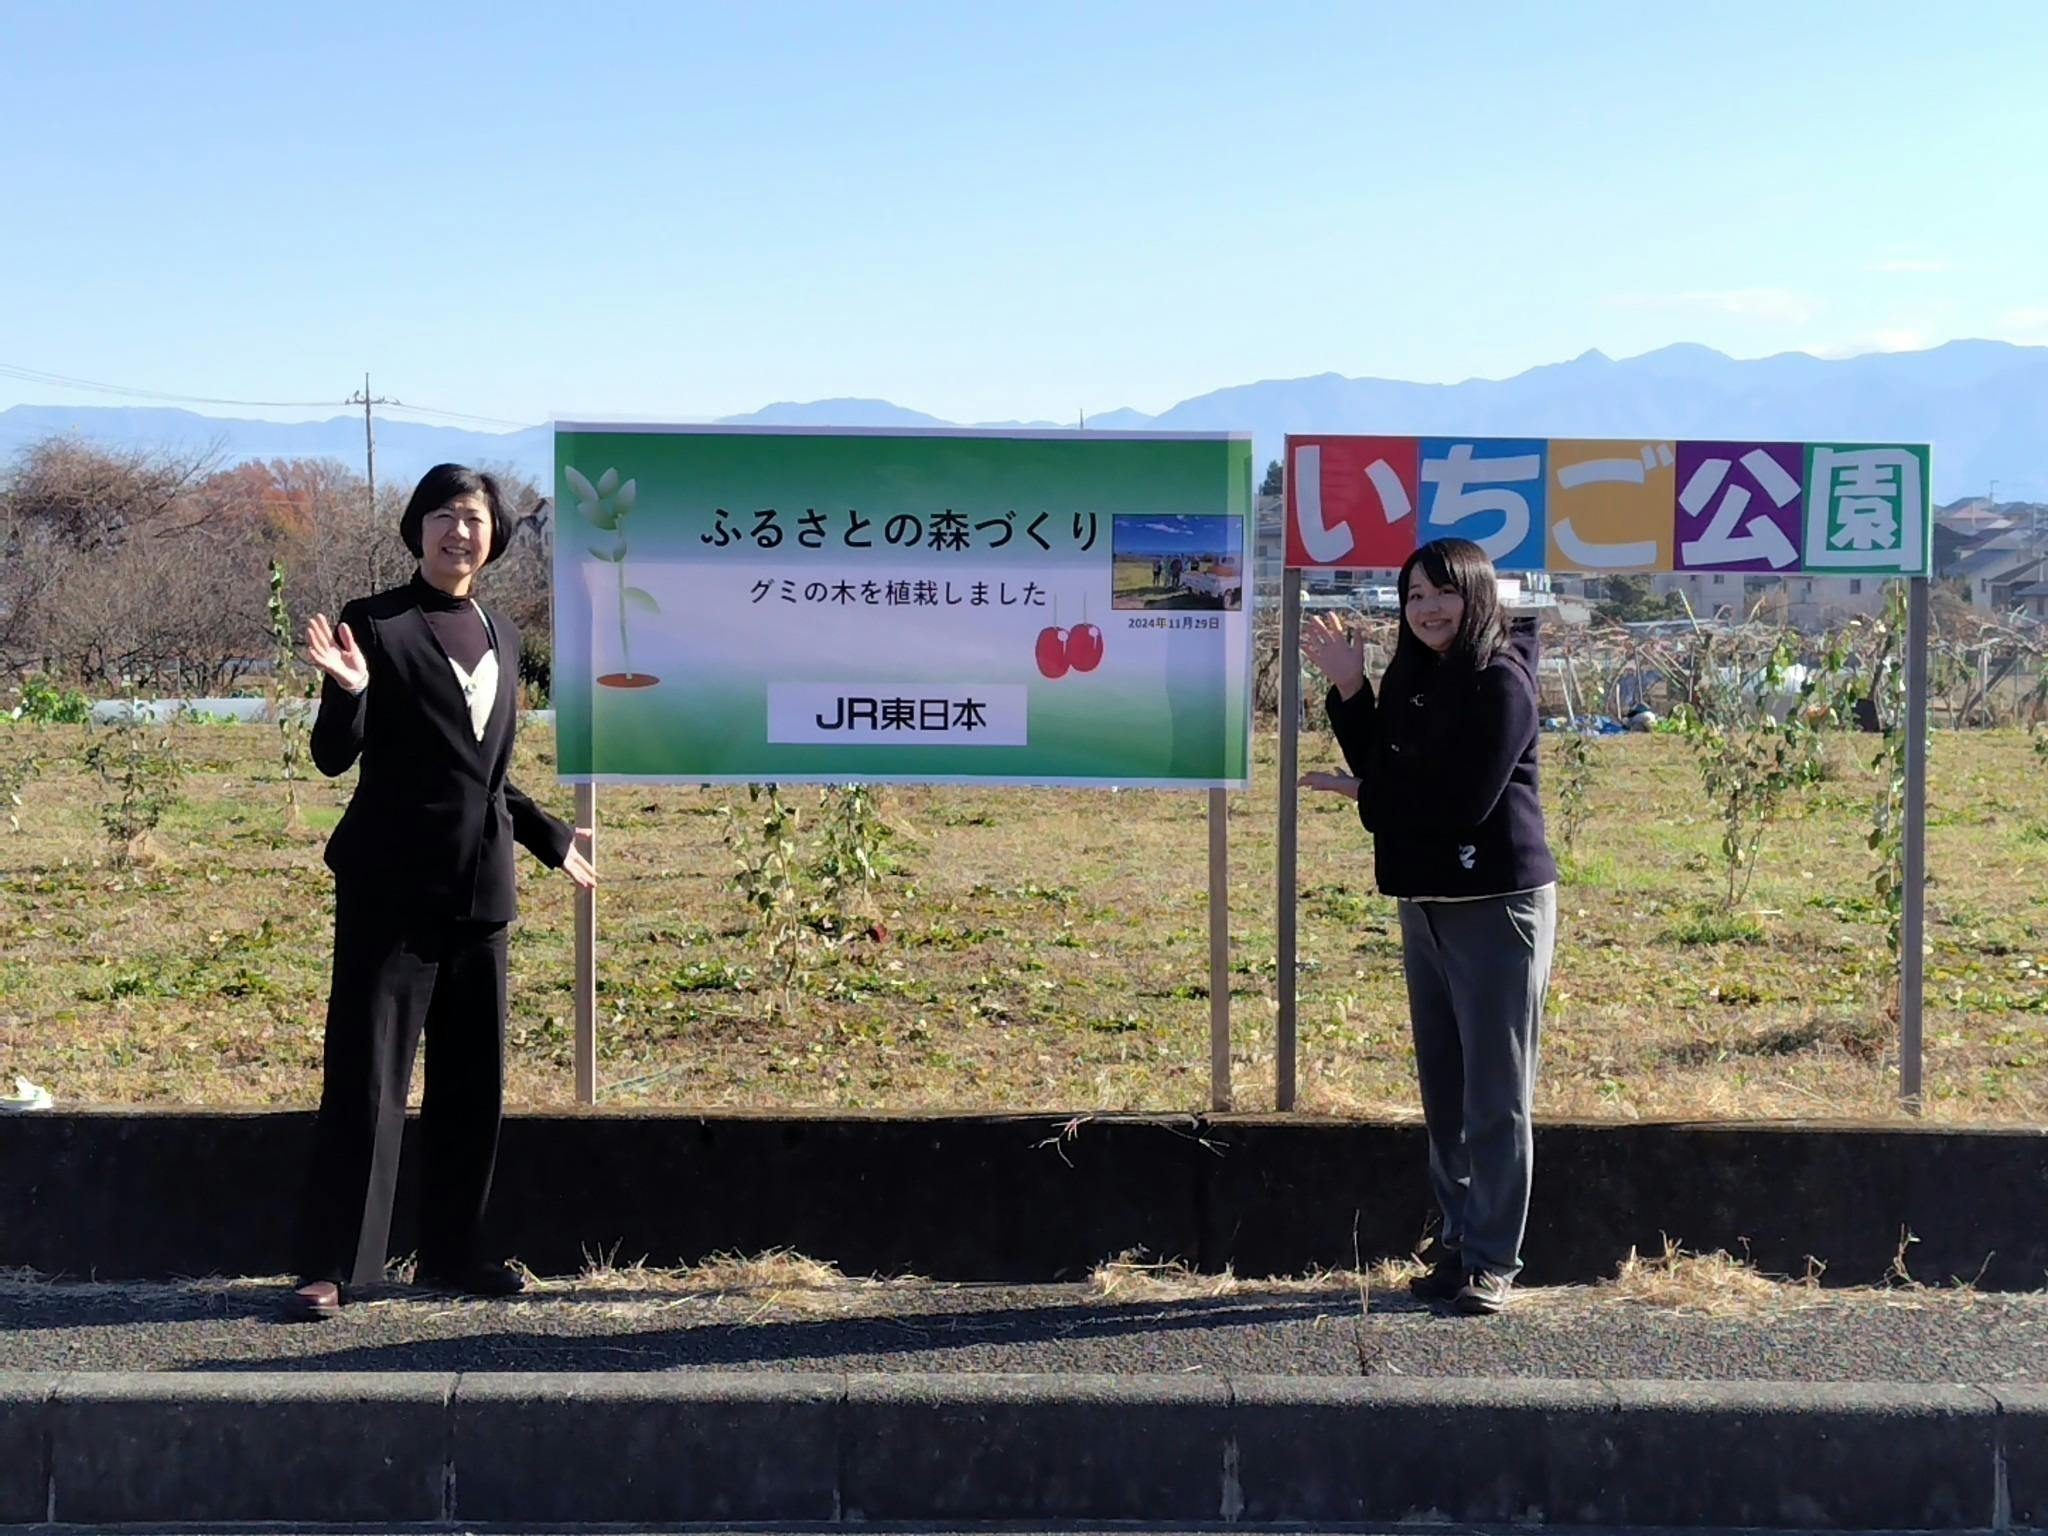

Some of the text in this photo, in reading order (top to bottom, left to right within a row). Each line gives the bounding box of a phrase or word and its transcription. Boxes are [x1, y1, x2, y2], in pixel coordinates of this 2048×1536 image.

[1295, 444, 1923, 570] いちご公園
[701, 508, 1098, 552] ふるさとの森づくり
[750, 579, 1047, 606] グミの木を植栽しました
[1128, 617, 1219, 629] 2024年11月29日
[816, 697, 987, 731] JR東日本
